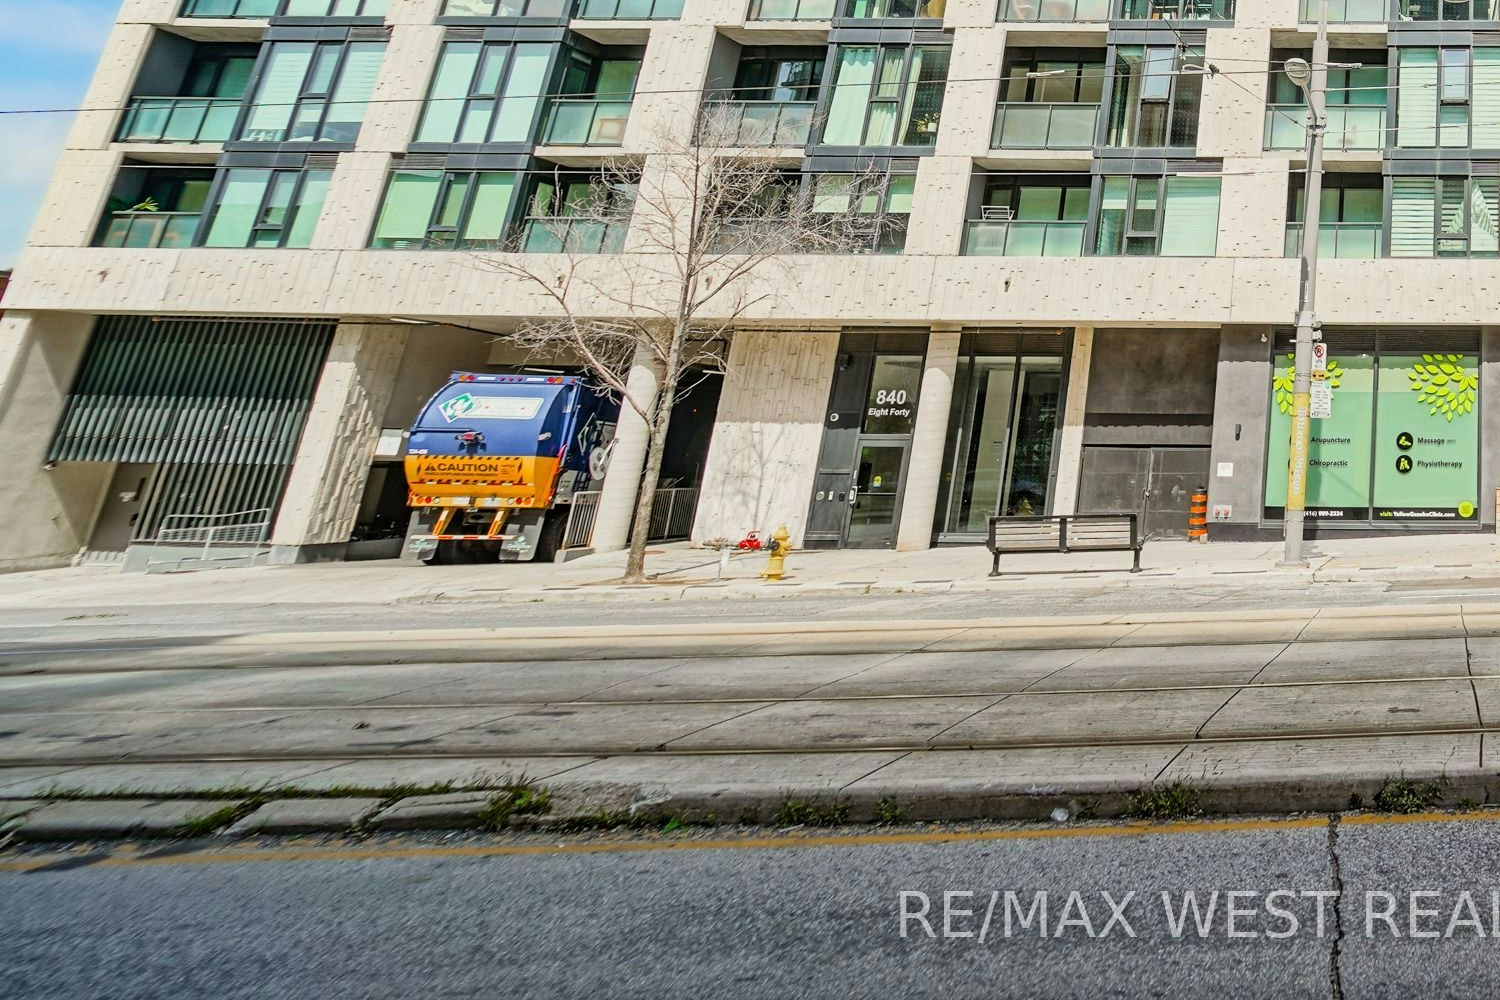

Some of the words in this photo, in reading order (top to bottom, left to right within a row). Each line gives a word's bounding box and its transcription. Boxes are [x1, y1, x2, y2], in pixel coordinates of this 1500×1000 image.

[876, 389, 907, 405] 840
[868, 408, 889, 417] Eight
[890, 408, 911, 418] Forty
[1310, 436, 1351, 444] Acupuncture
[1417, 436, 1445, 446] Massage
[437, 462, 498, 472] CAUTION
[1309, 459, 1348, 468] Chiropractic
[1417, 460, 1463, 469] Physiotherapy
